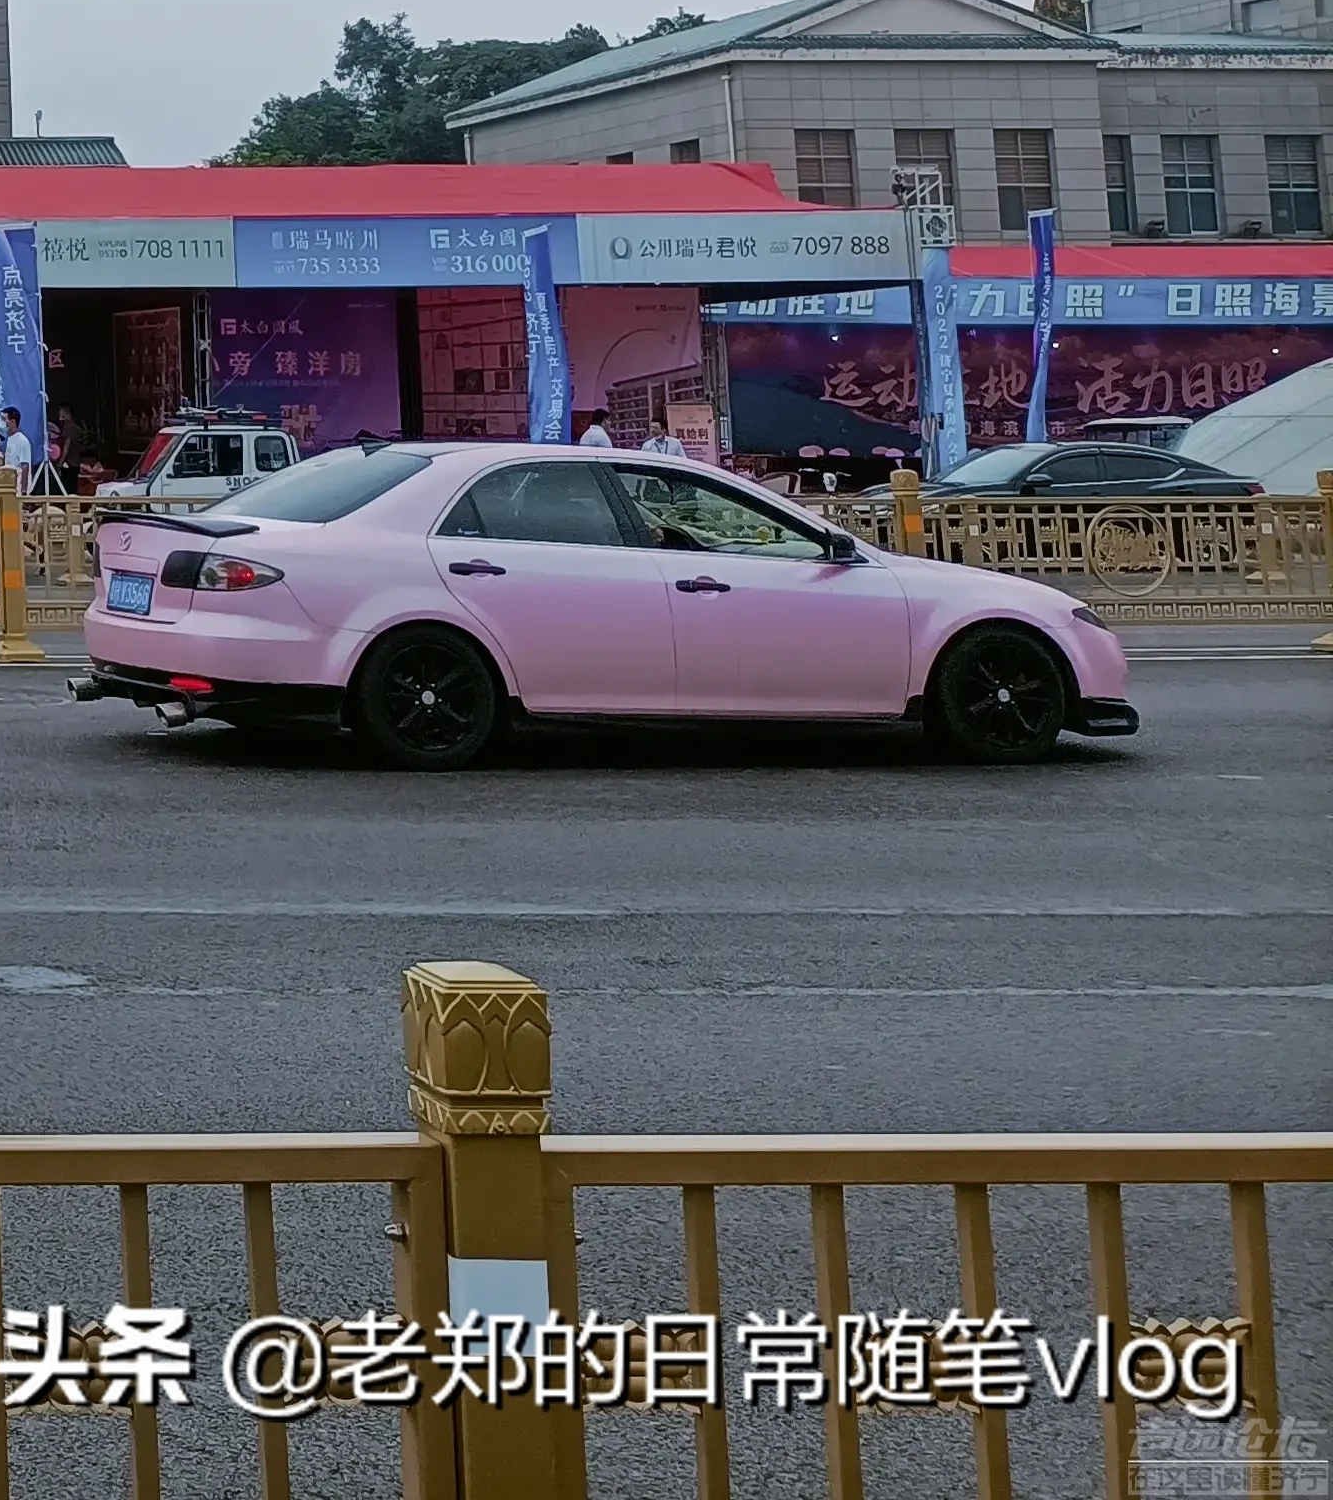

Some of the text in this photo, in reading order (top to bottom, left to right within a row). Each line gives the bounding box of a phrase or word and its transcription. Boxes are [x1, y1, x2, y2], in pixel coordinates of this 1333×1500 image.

[41, 237, 90, 263] 禧悦
[134, 239, 173, 258] 708
[178, 240, 223, 258] 1111
[792, 236, 843, 256] 7097
[850, 236, 890, 255] 888
[297, 257, 330, 274] 735
[336, 257, 380, 275] 3333
[450, 254, 488, 273] 316
